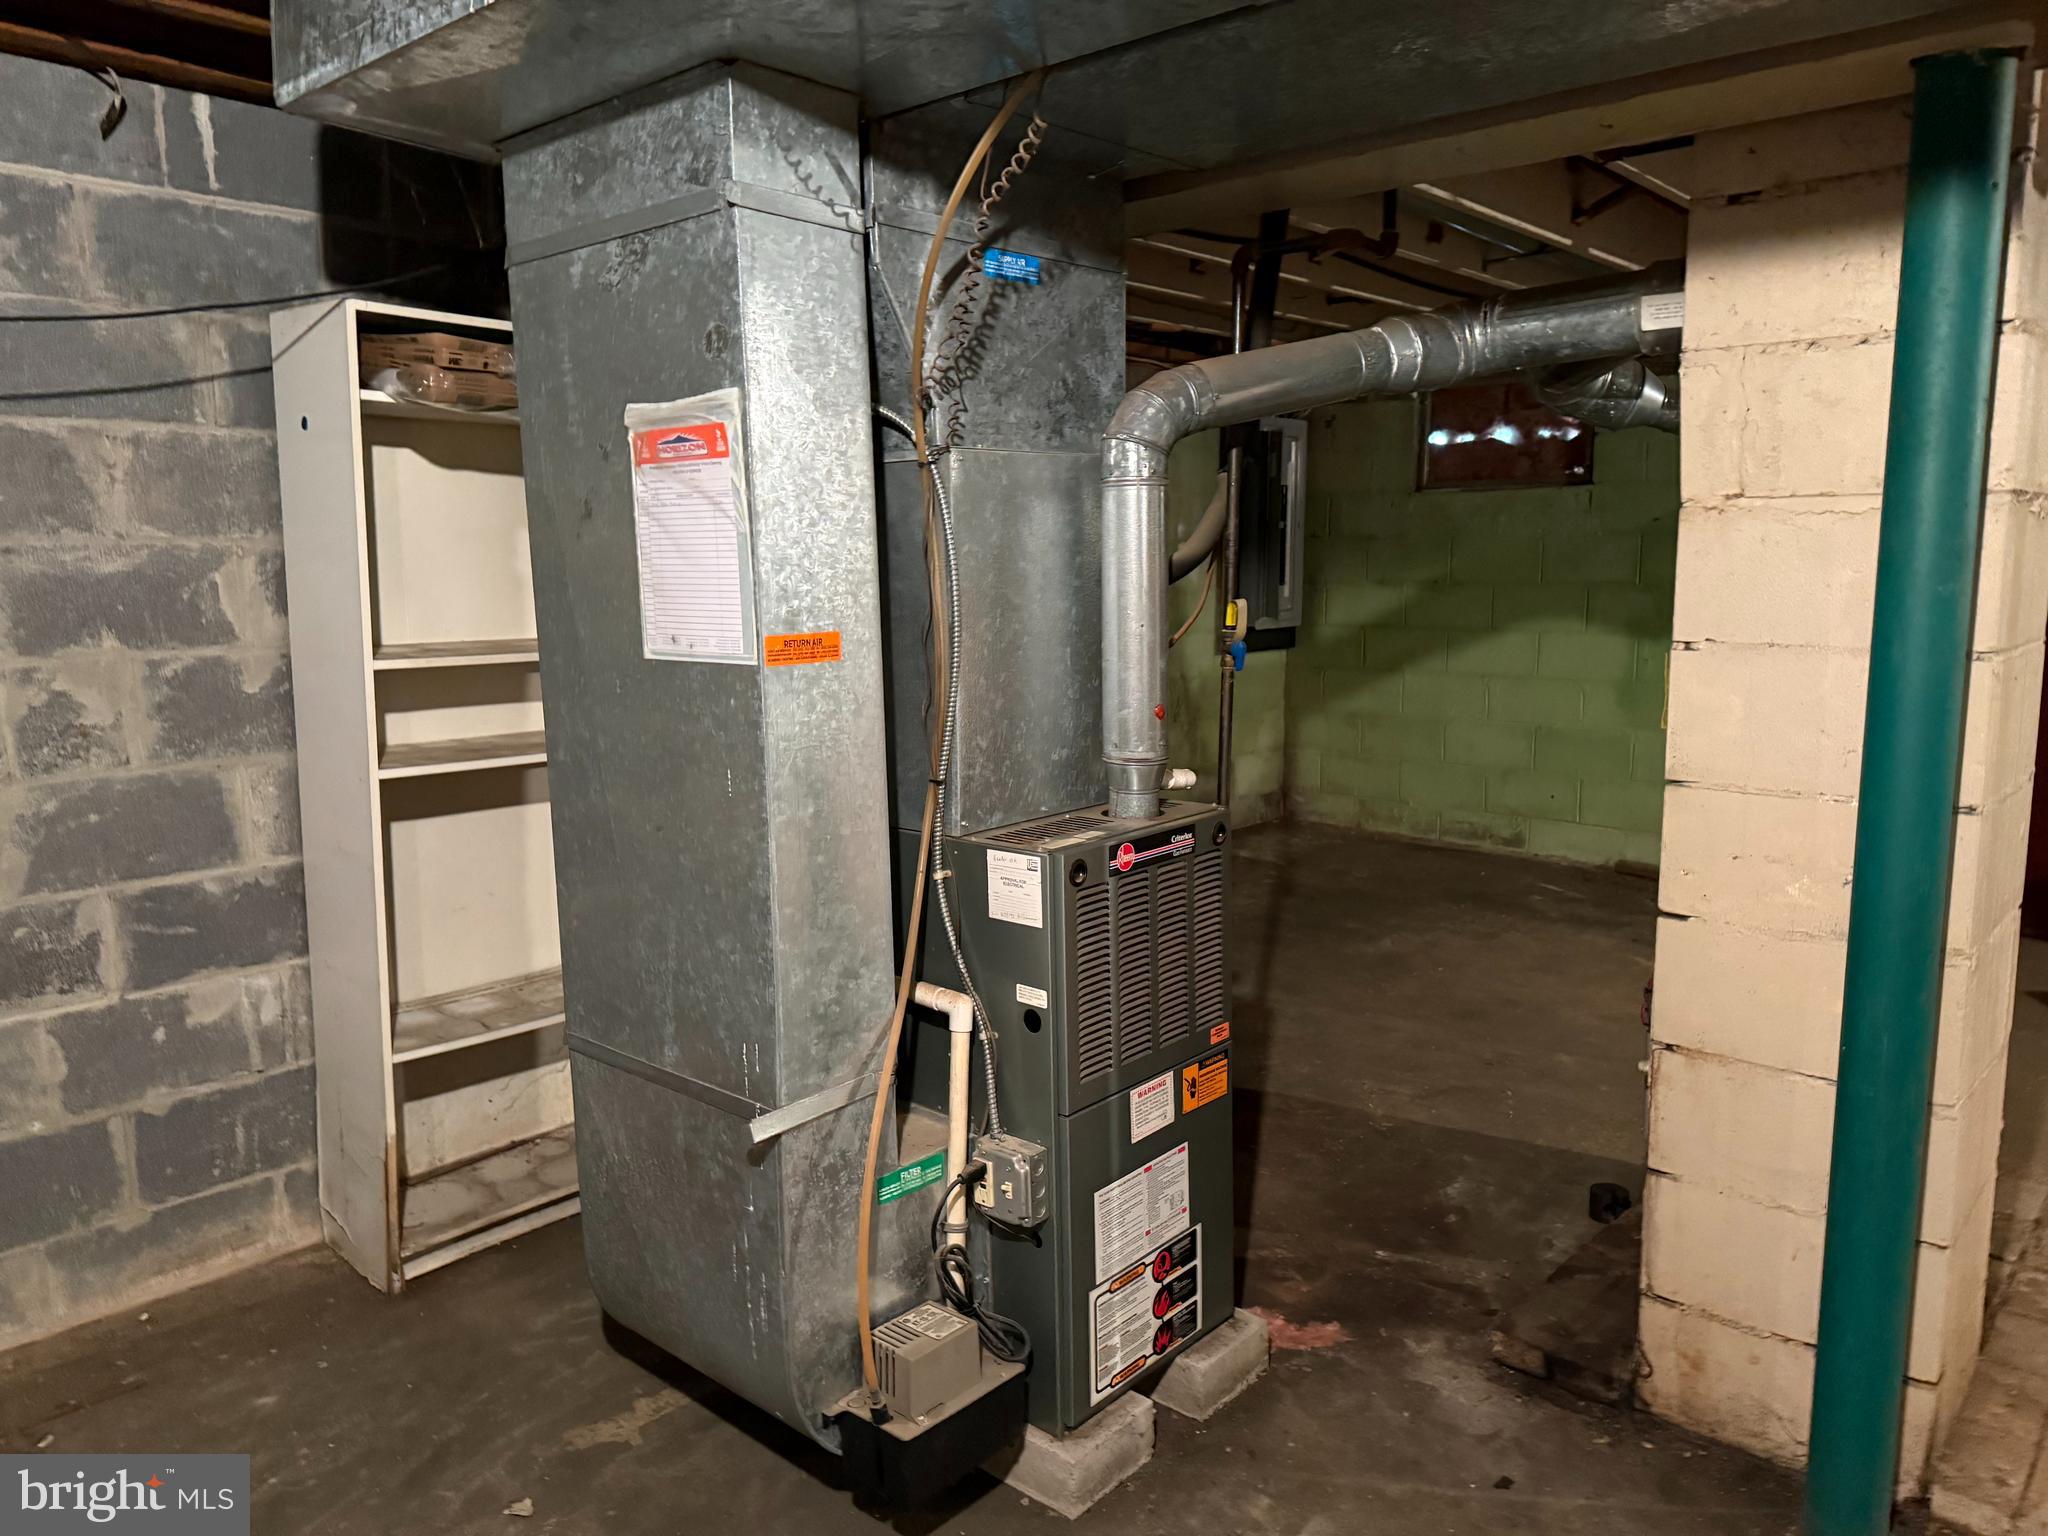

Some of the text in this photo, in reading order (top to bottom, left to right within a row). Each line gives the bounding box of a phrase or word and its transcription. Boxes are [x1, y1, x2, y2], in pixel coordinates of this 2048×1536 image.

[657, 442, 706, 454] HORIZON
[783, 638, 823, 648] RETURN AIR
[1137, 1080, 1167, 1099] WARNING
[901, 1166, 921, 1183] FILTER
